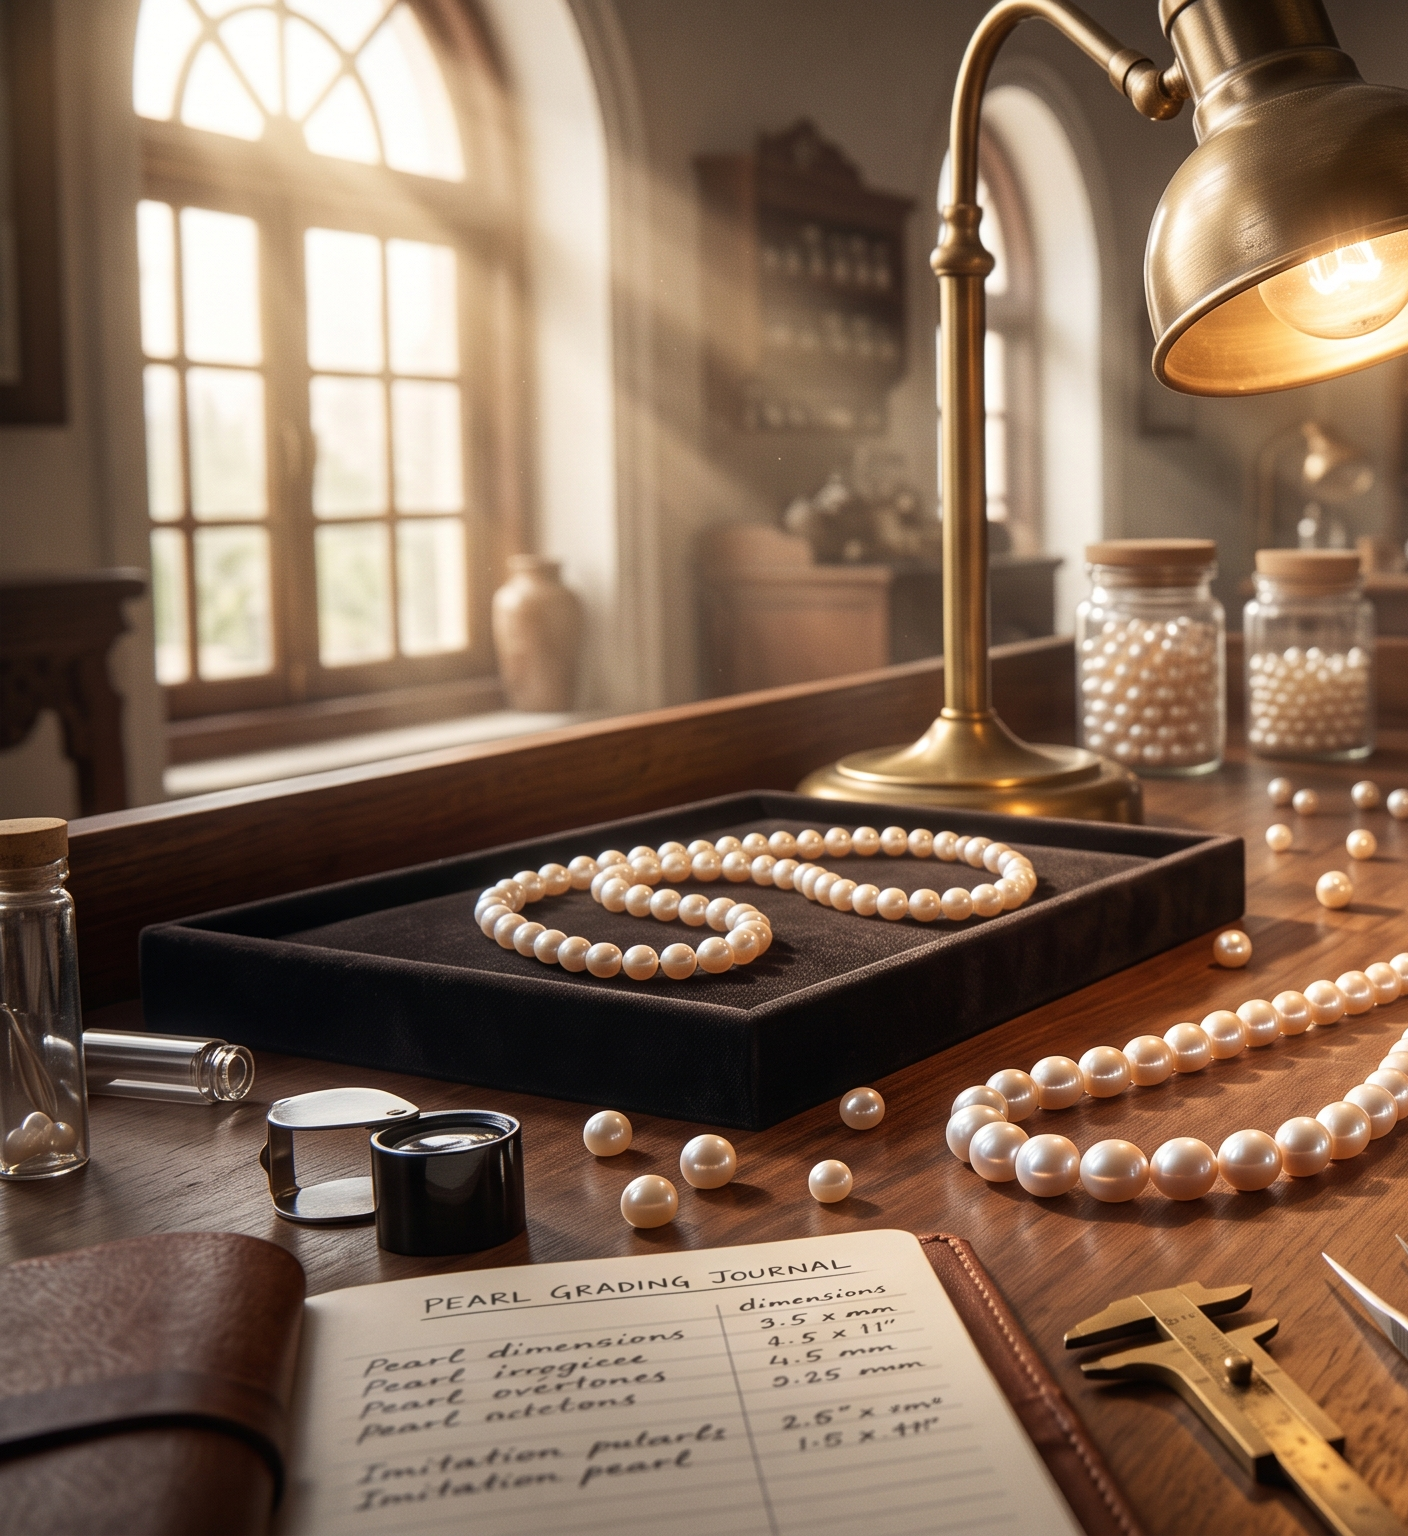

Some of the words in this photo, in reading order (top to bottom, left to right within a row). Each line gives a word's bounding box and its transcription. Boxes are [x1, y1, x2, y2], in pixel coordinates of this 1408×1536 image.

[424, 1291, 532, 1314] PEARL
[550, 1275, 691, 1301] GRADING
[708, 1258, 853, 1285] JOURNAL
[738, 1284, 887, 1312] dimensions
[760, 1313, 809, 1330] 3.5
[363, 1348, 466, 1378] Pearl
[487, 1330, 685, 1359] dimensions
[767, 1331, 818, 1347] 4.5
[769, 1348, 824, 1366] 4.5
[362, 1368, 466, 1398] Pearl
[358, 1448, 562, 1485] Imitation
[355, 1472, 560, 1512] Imitation
